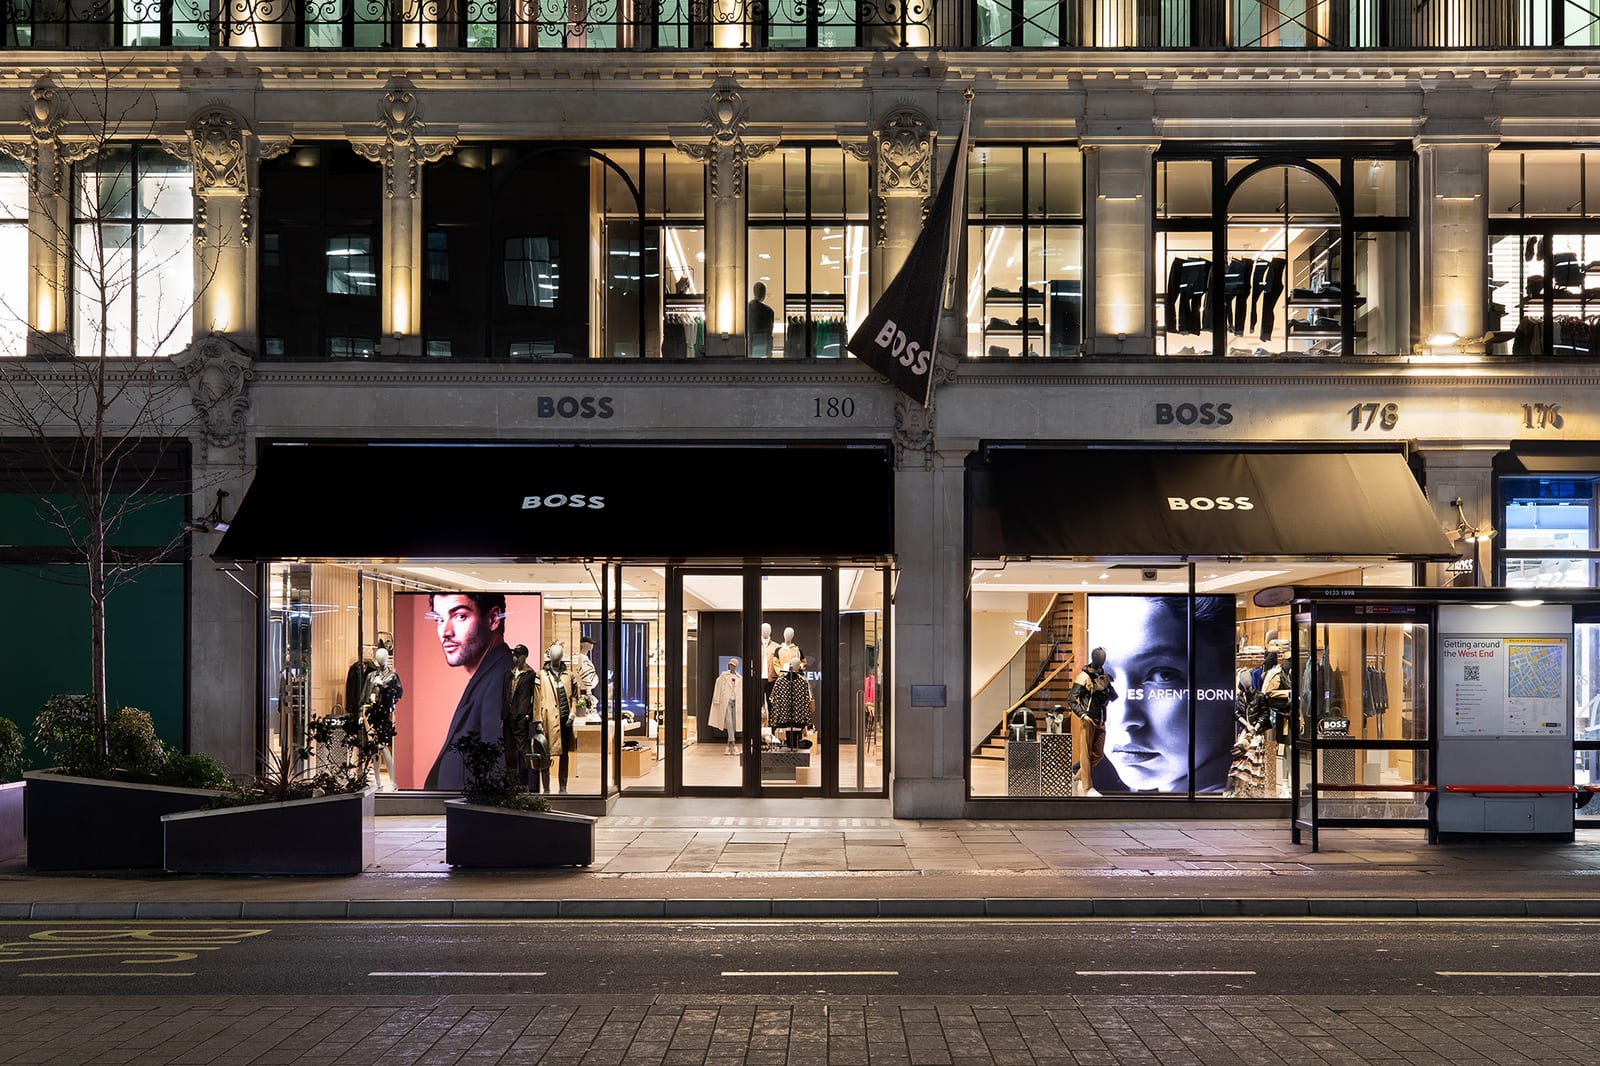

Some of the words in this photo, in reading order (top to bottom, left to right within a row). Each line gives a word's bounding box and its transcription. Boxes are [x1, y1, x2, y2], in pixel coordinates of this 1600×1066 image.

[874, 319, 931, 376] BOSS
[537, 396, 614, 419] BOSS
[812, 397, 855, 419] 180
[1155, 402, 1234, 426] BOSS
[1349, 402, 1399, 429] 178
[1521, 402, 1562, 428] 176
[521, 493, 606, 510] BOSS
[1167, 496, 1255, 512] BOSS
[1444, 640, 1472, 650] Getting
[1473, 640, 1500, 649] around
[1444, 650, 1457, 658] the
[1457, 650, 1478, 658] West
[1479, 650, 1495, 658] End
[1148, 689, 1191, 700] AREN'T
[1197, 689, 1234, 700] BORN
[1324, 720, 1347, 729] BOSS
